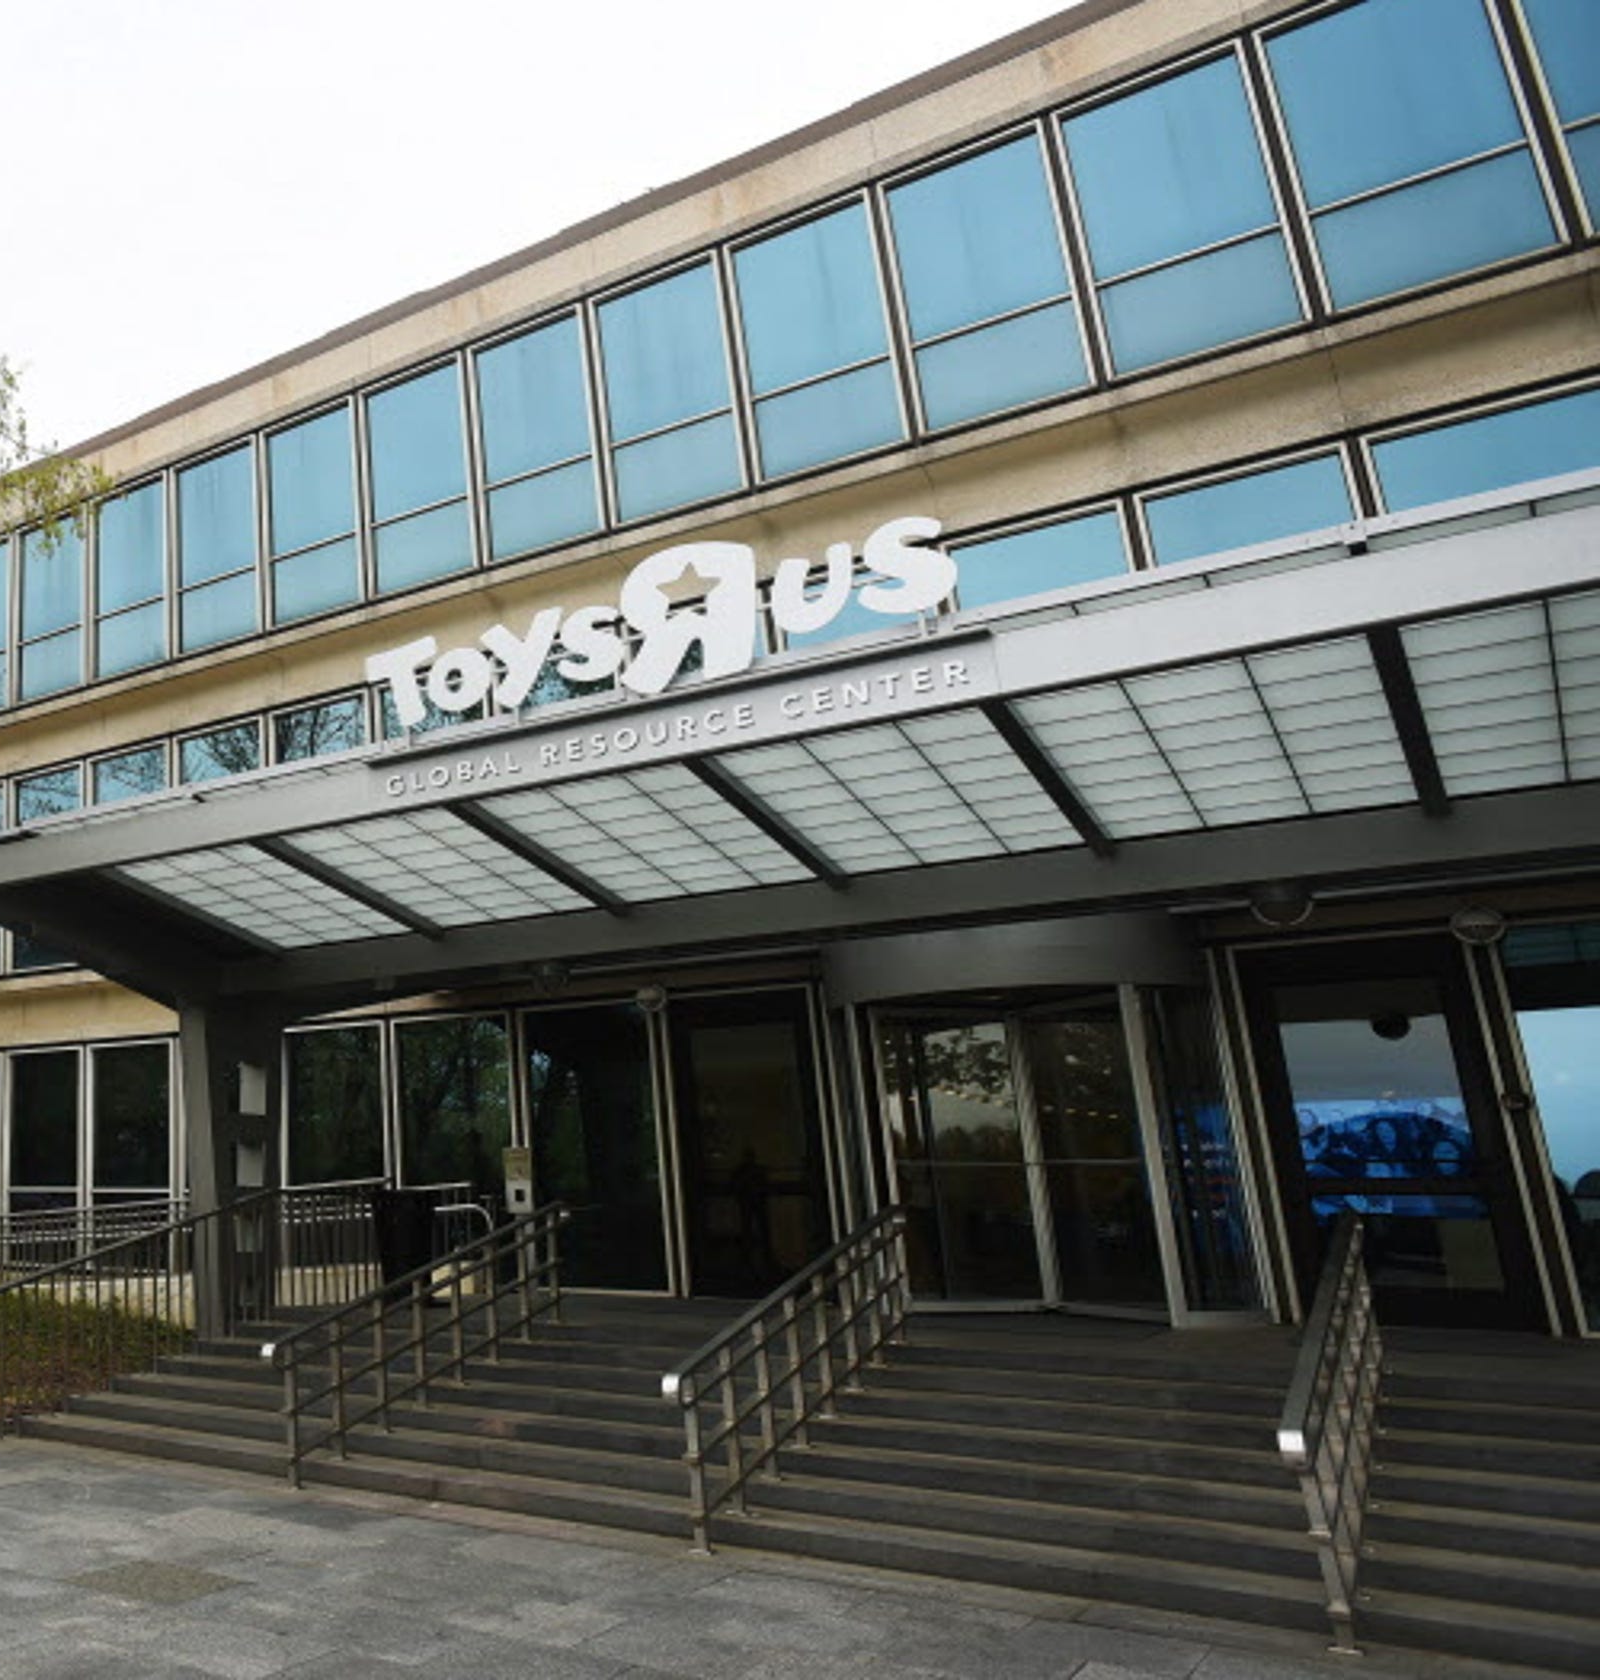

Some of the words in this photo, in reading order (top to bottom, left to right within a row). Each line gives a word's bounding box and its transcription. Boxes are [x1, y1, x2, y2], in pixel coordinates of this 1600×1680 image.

[386, 751, 522, 797] GLOBAL
[539, 702, 756, 768] RESOURCE
[780, 659, 970, 719] CENTER
